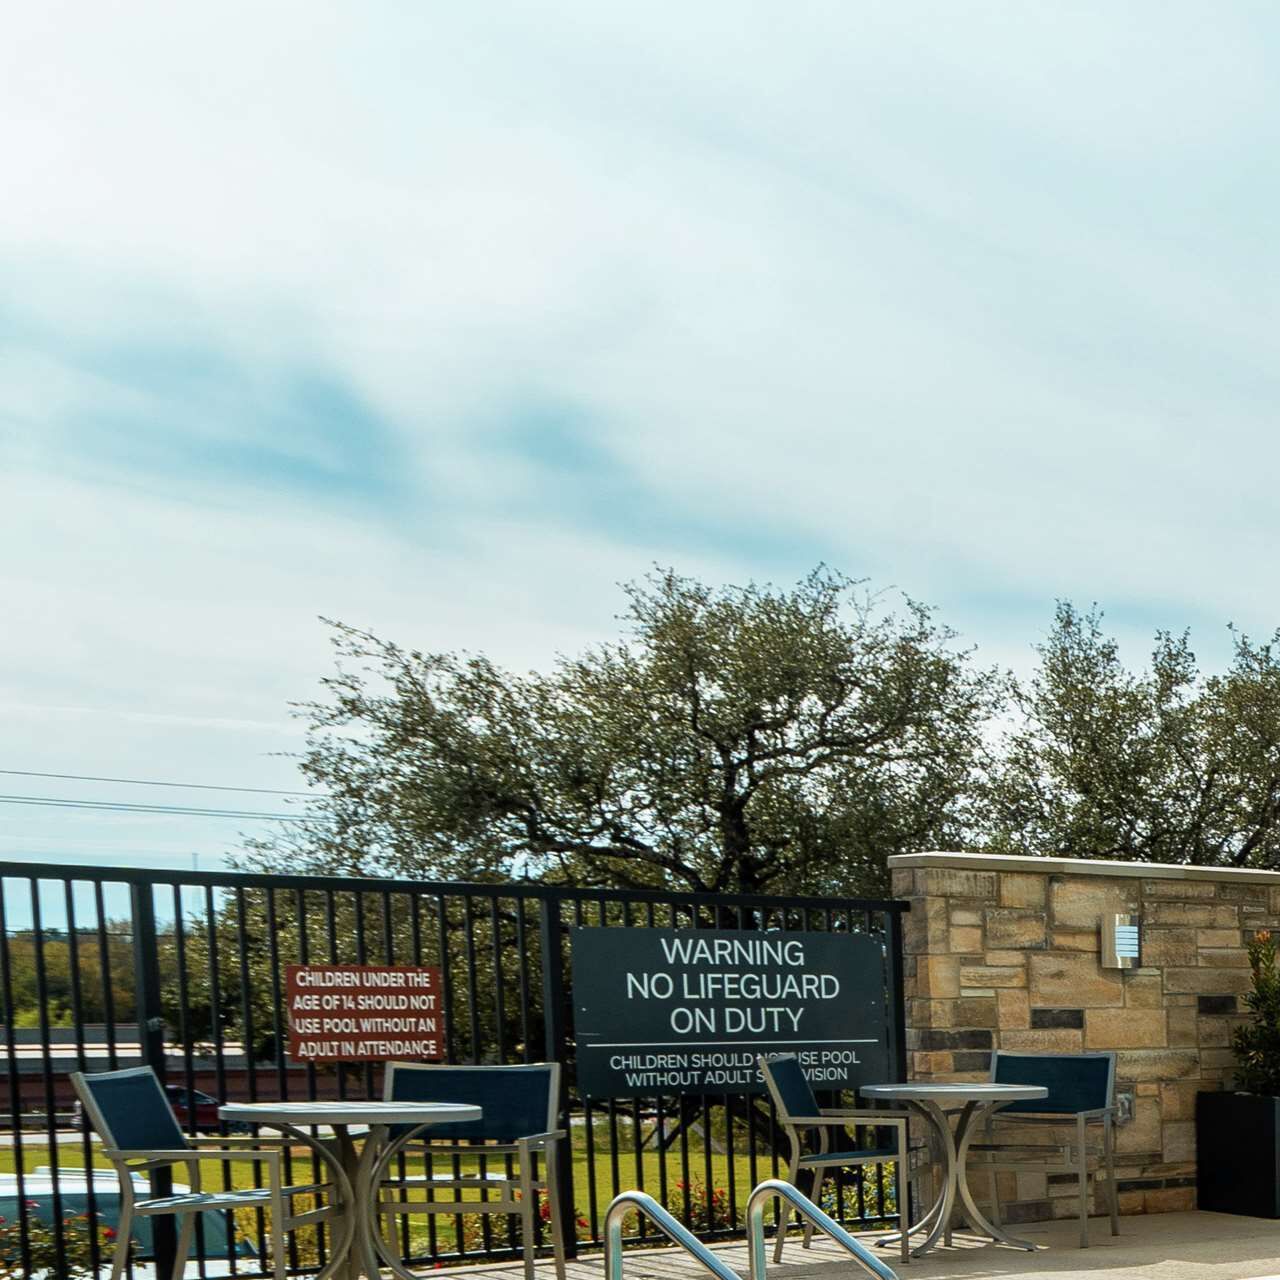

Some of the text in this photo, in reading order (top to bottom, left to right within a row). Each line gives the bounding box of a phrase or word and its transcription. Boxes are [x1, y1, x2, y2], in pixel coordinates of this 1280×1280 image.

[660, 938, 805, 967] WARNING
[296, 971, 431, 988] CHILDREN UNDER THE
[626, 973, 840, 1000] NO LIFEGUARD
[293, 995, 435, 1010] AGE OF 14 SHOULD NOT
[296, 1018, 436, 1033] USE POOL WITHOUT AN
[670, 1007, 805, 1034] ON DUTY
[298, 1040, 437, 1057] ADULT IN ATTENDANCE
[610, 1054, 688, 1070] CHILDREN
[691, 1052, 754, 1068] SHOULD
[798, 1051, 819, 1065] SE
[822, 1050, 861, 1064] POOL
[626, 1071, 700, 1087] WITHOUT
[704, 1069, 751, 1084] ADULT
